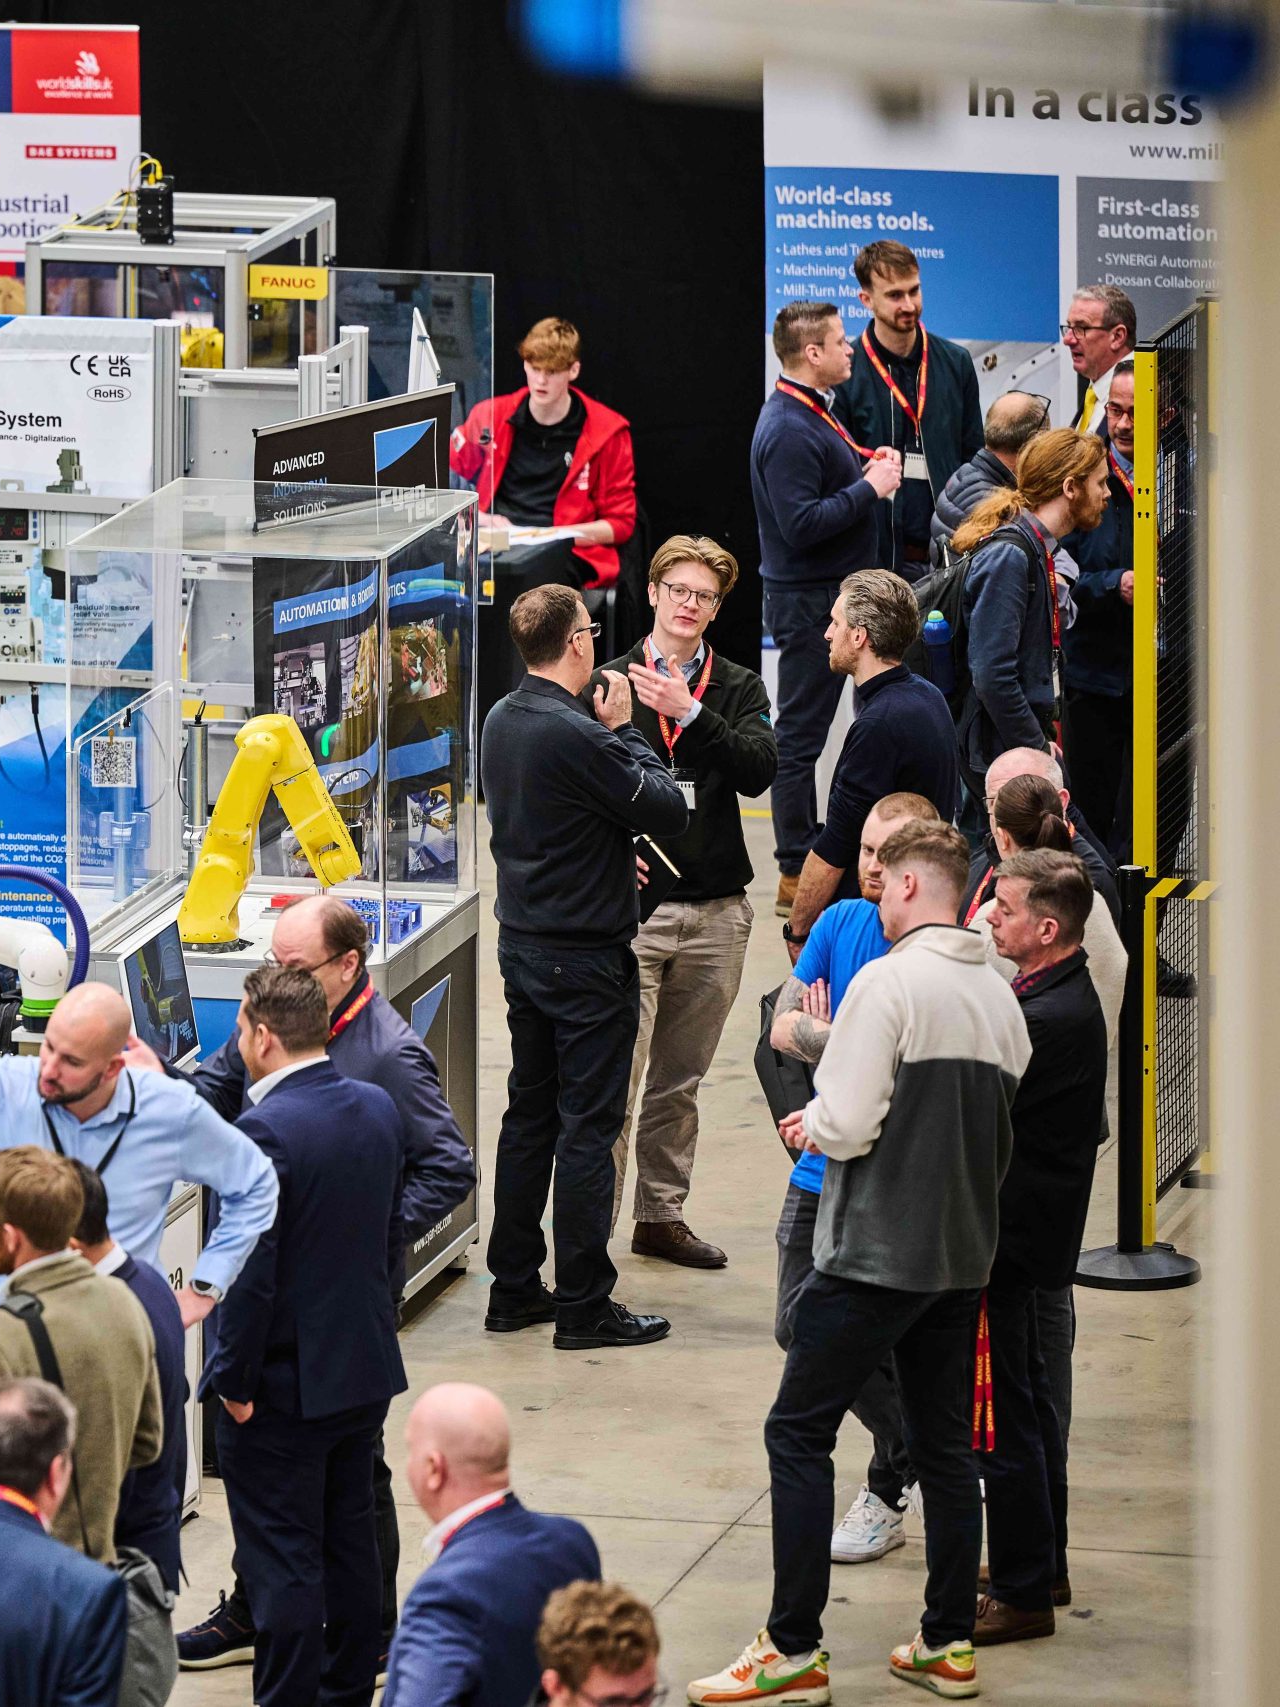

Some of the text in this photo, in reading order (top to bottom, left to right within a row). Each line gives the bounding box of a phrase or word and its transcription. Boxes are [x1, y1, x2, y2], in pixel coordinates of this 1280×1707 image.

[1032, 87, 1061, 120] a
[1078, 83, 1203, 126] class
[29, 146, 114, 159] BAE SYSTEMS
[774, 185, 893, 206] World-class
[1097, 196, 1200, 218] First-class
[775, 209, 935, 232] machines tools.
[1097, 222, 1219, 242] automation
[783, 243, 848, 256] Lathes and
[783, 263, 846, 279] Machining
[261, 276, 316, 289] FANUC
[1105, 273, 1151, 287] Doosan
[783, 283, 835, 297] Mill-Turn
[109, 355, 130, 366] UK
[93, 388, 125, 399] RoHS
[24, 433, 77, 444] Digitalization
[272, 450, 326, 476] ADVANCED
[272, 500, 327, 526] SOLUTIONS
[7, 832, 59, 843] automatically
[12, 854, 29, 862] and
[30, 855, 43, 863] the
[44, 855, 63, 864] CO2
[35, 905, 53, 913] data
[974, 1402, 982, 1432] FANUC
